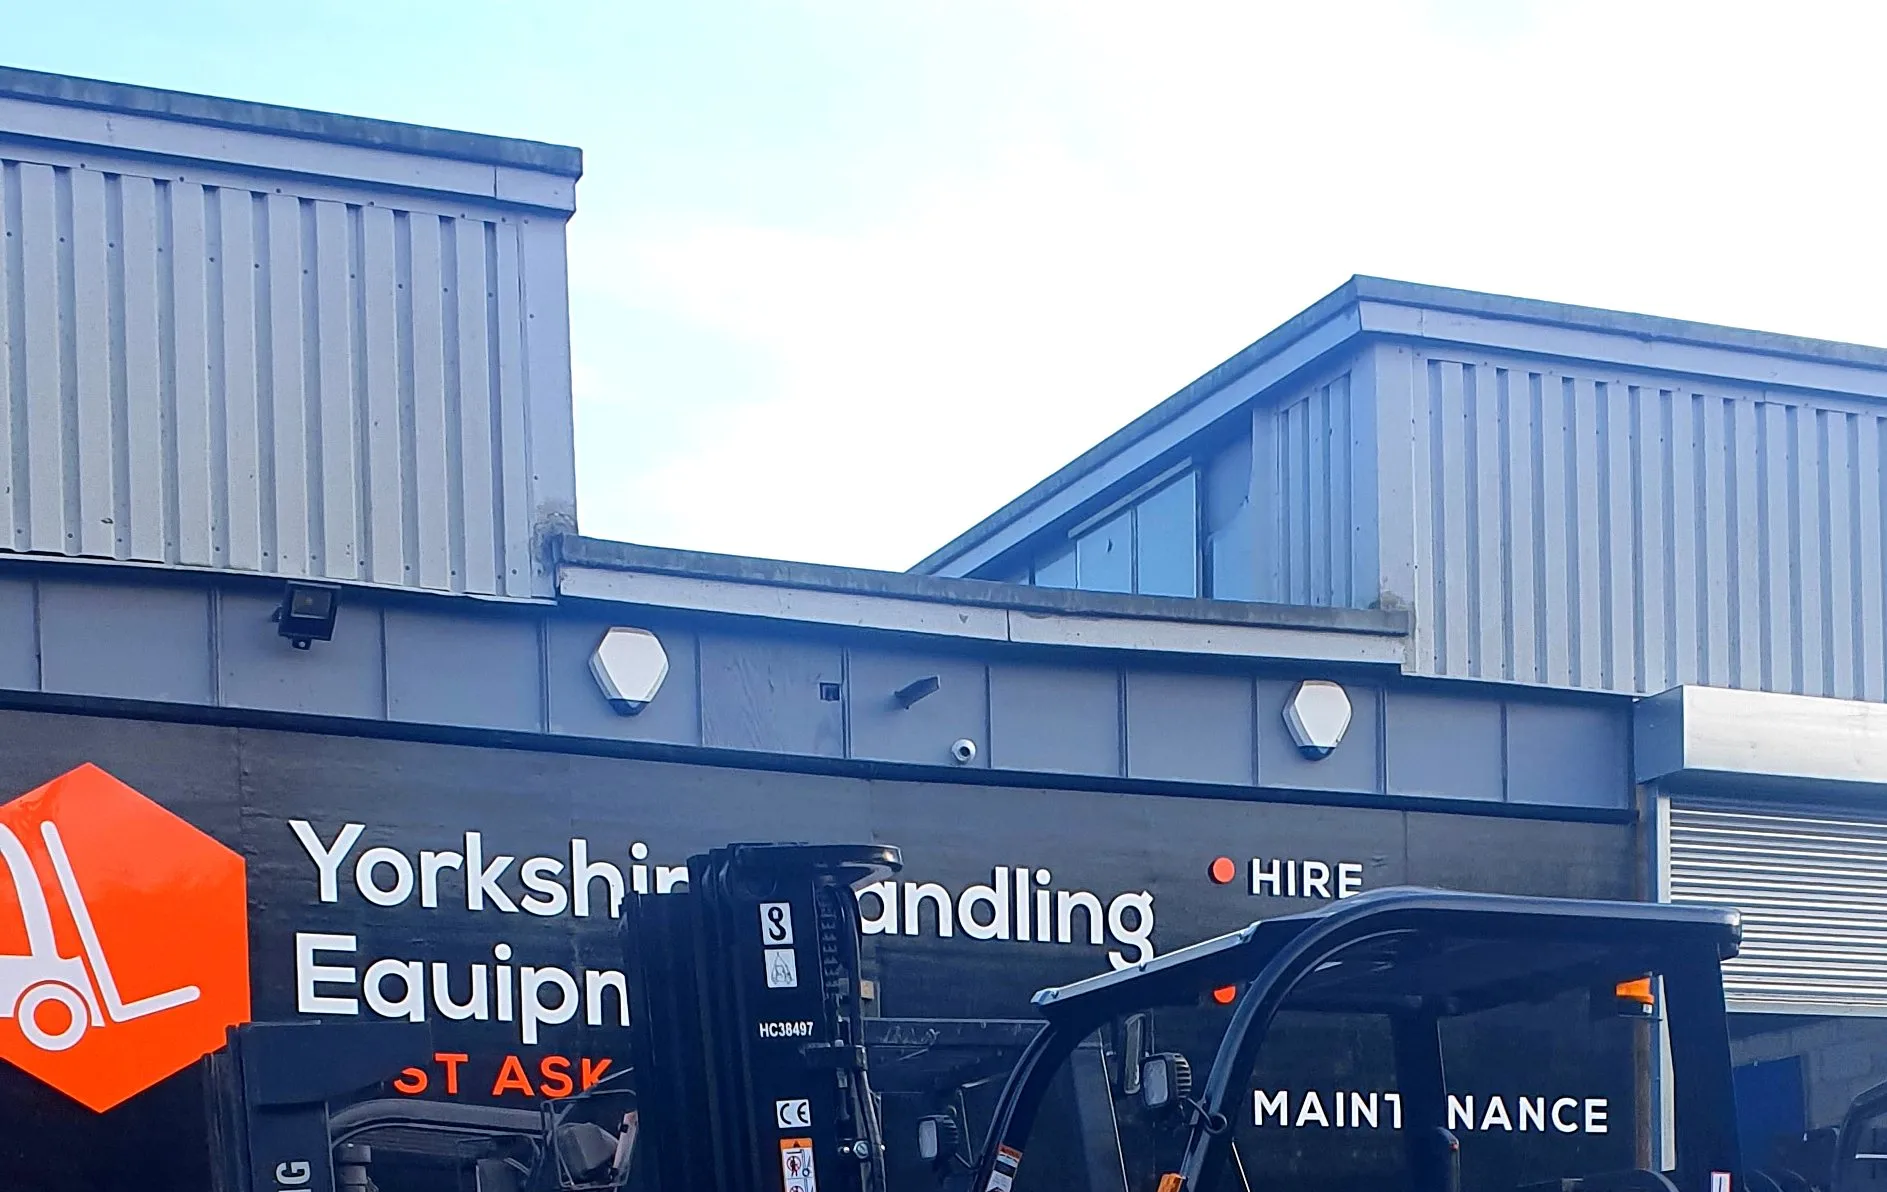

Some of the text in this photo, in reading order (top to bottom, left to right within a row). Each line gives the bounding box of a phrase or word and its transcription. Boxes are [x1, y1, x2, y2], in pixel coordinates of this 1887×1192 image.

[288, 820, 1154, 970] Yorkshir andling
[1252, 858, 1363, 899] HIRE
[759, 1021, 814, 1038] HC38497
[492, 1055, 612, 1097] ASK
[779, 1102, 808, 1125] CE
[1253, 1090, 1608, 1133] MAINTNANCE
